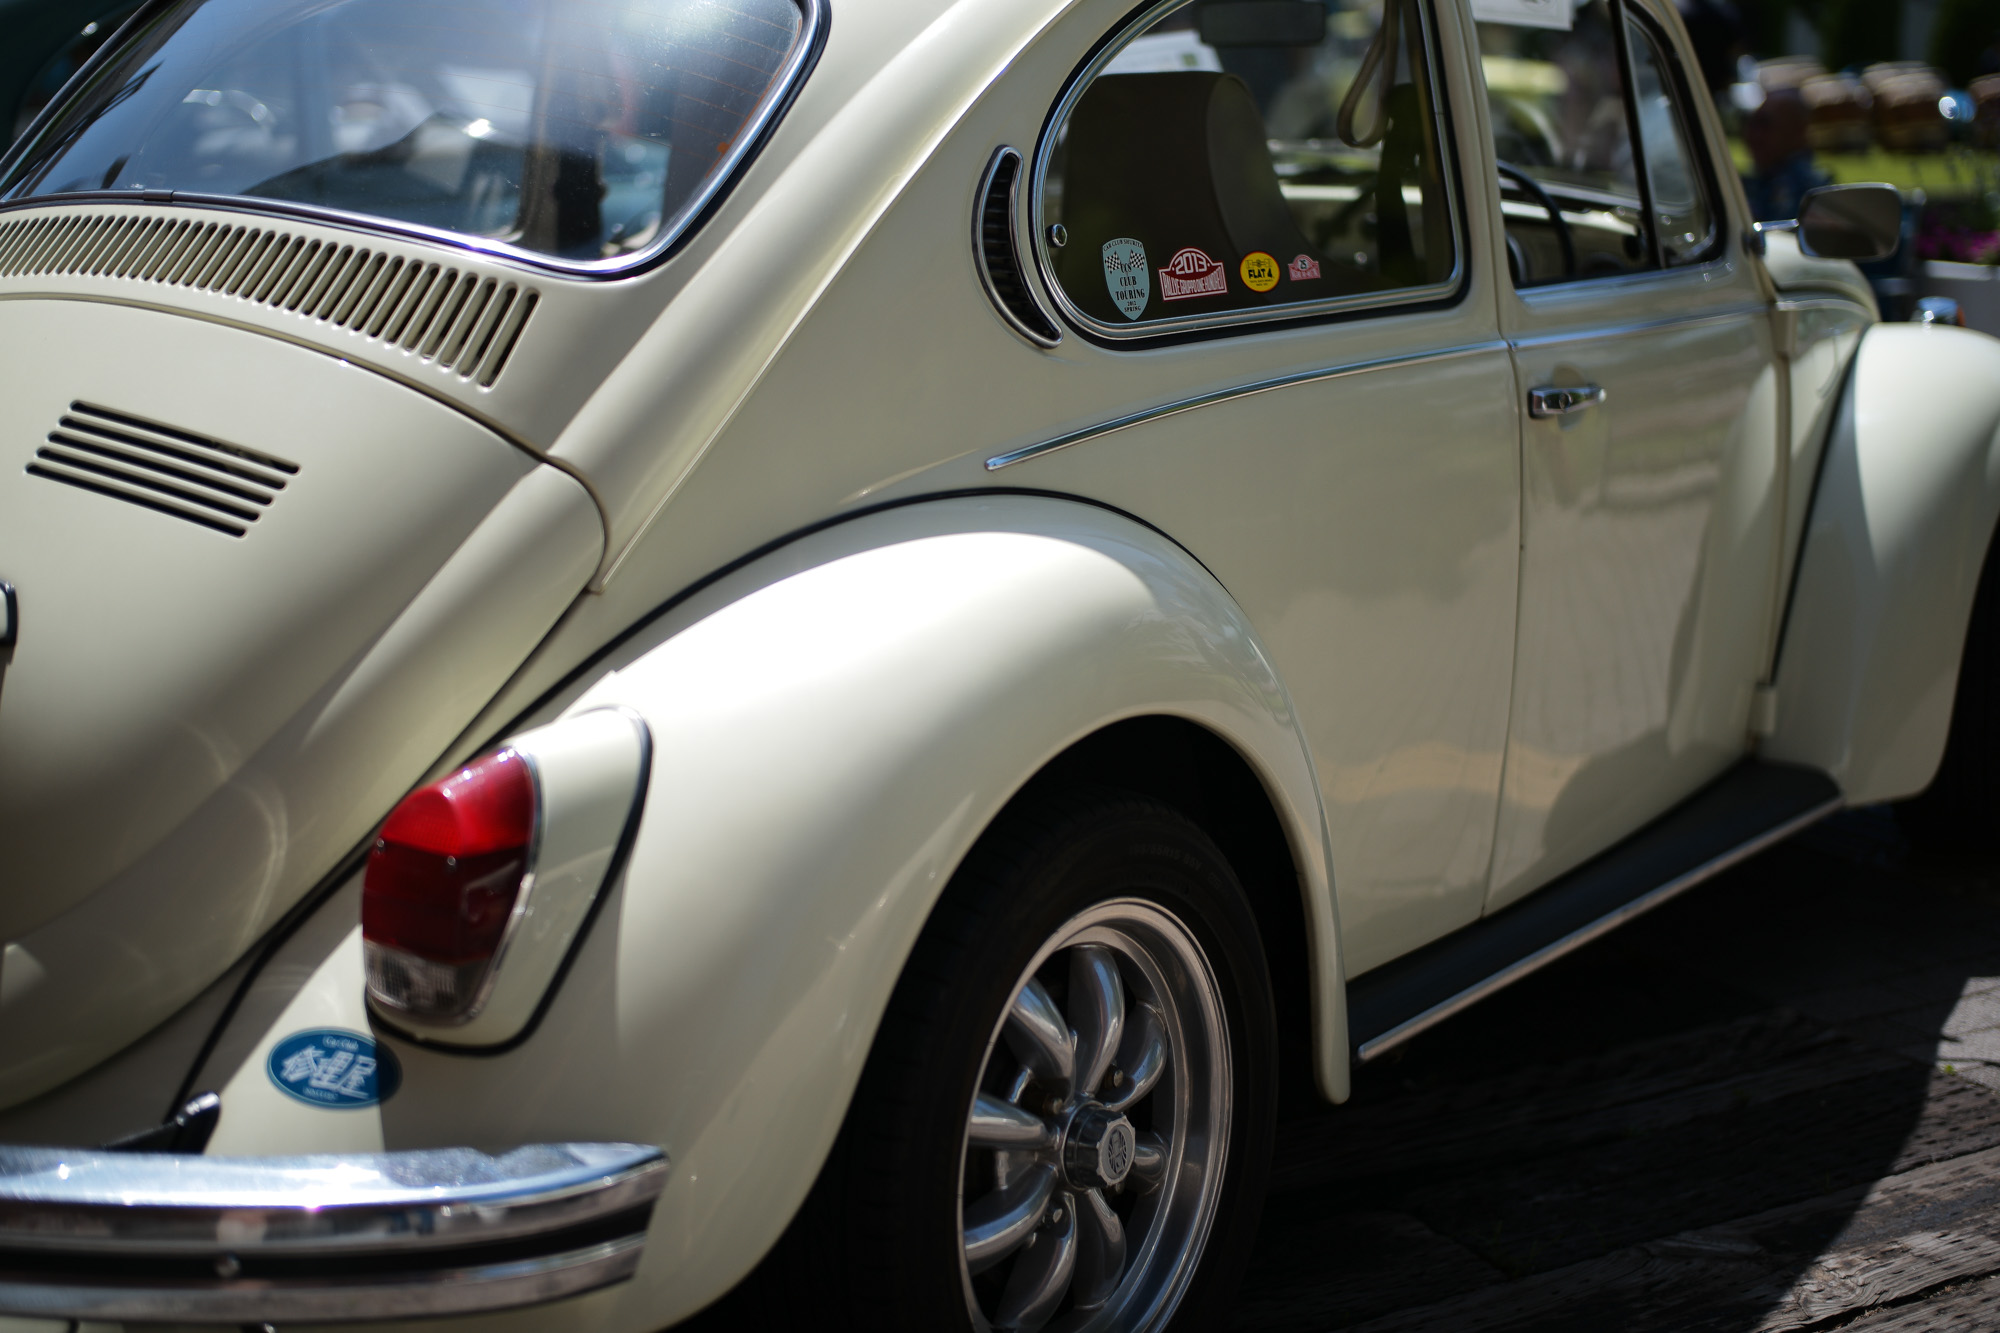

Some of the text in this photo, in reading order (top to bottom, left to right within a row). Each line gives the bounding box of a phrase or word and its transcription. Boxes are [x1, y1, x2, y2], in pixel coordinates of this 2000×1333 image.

[1112, 239, 1123, 247] CLUB
[1175, 252, 1207, 275] 2013
[1248, 267, 1273, 279] FLAT 4
[1119, 276, 1137, 287] CLUB
[1115, 288, 1146, 301] TOURING
[1124, 305, 1142, 313] SPRING
[280, 1045, 376, 1099] 修理屋
